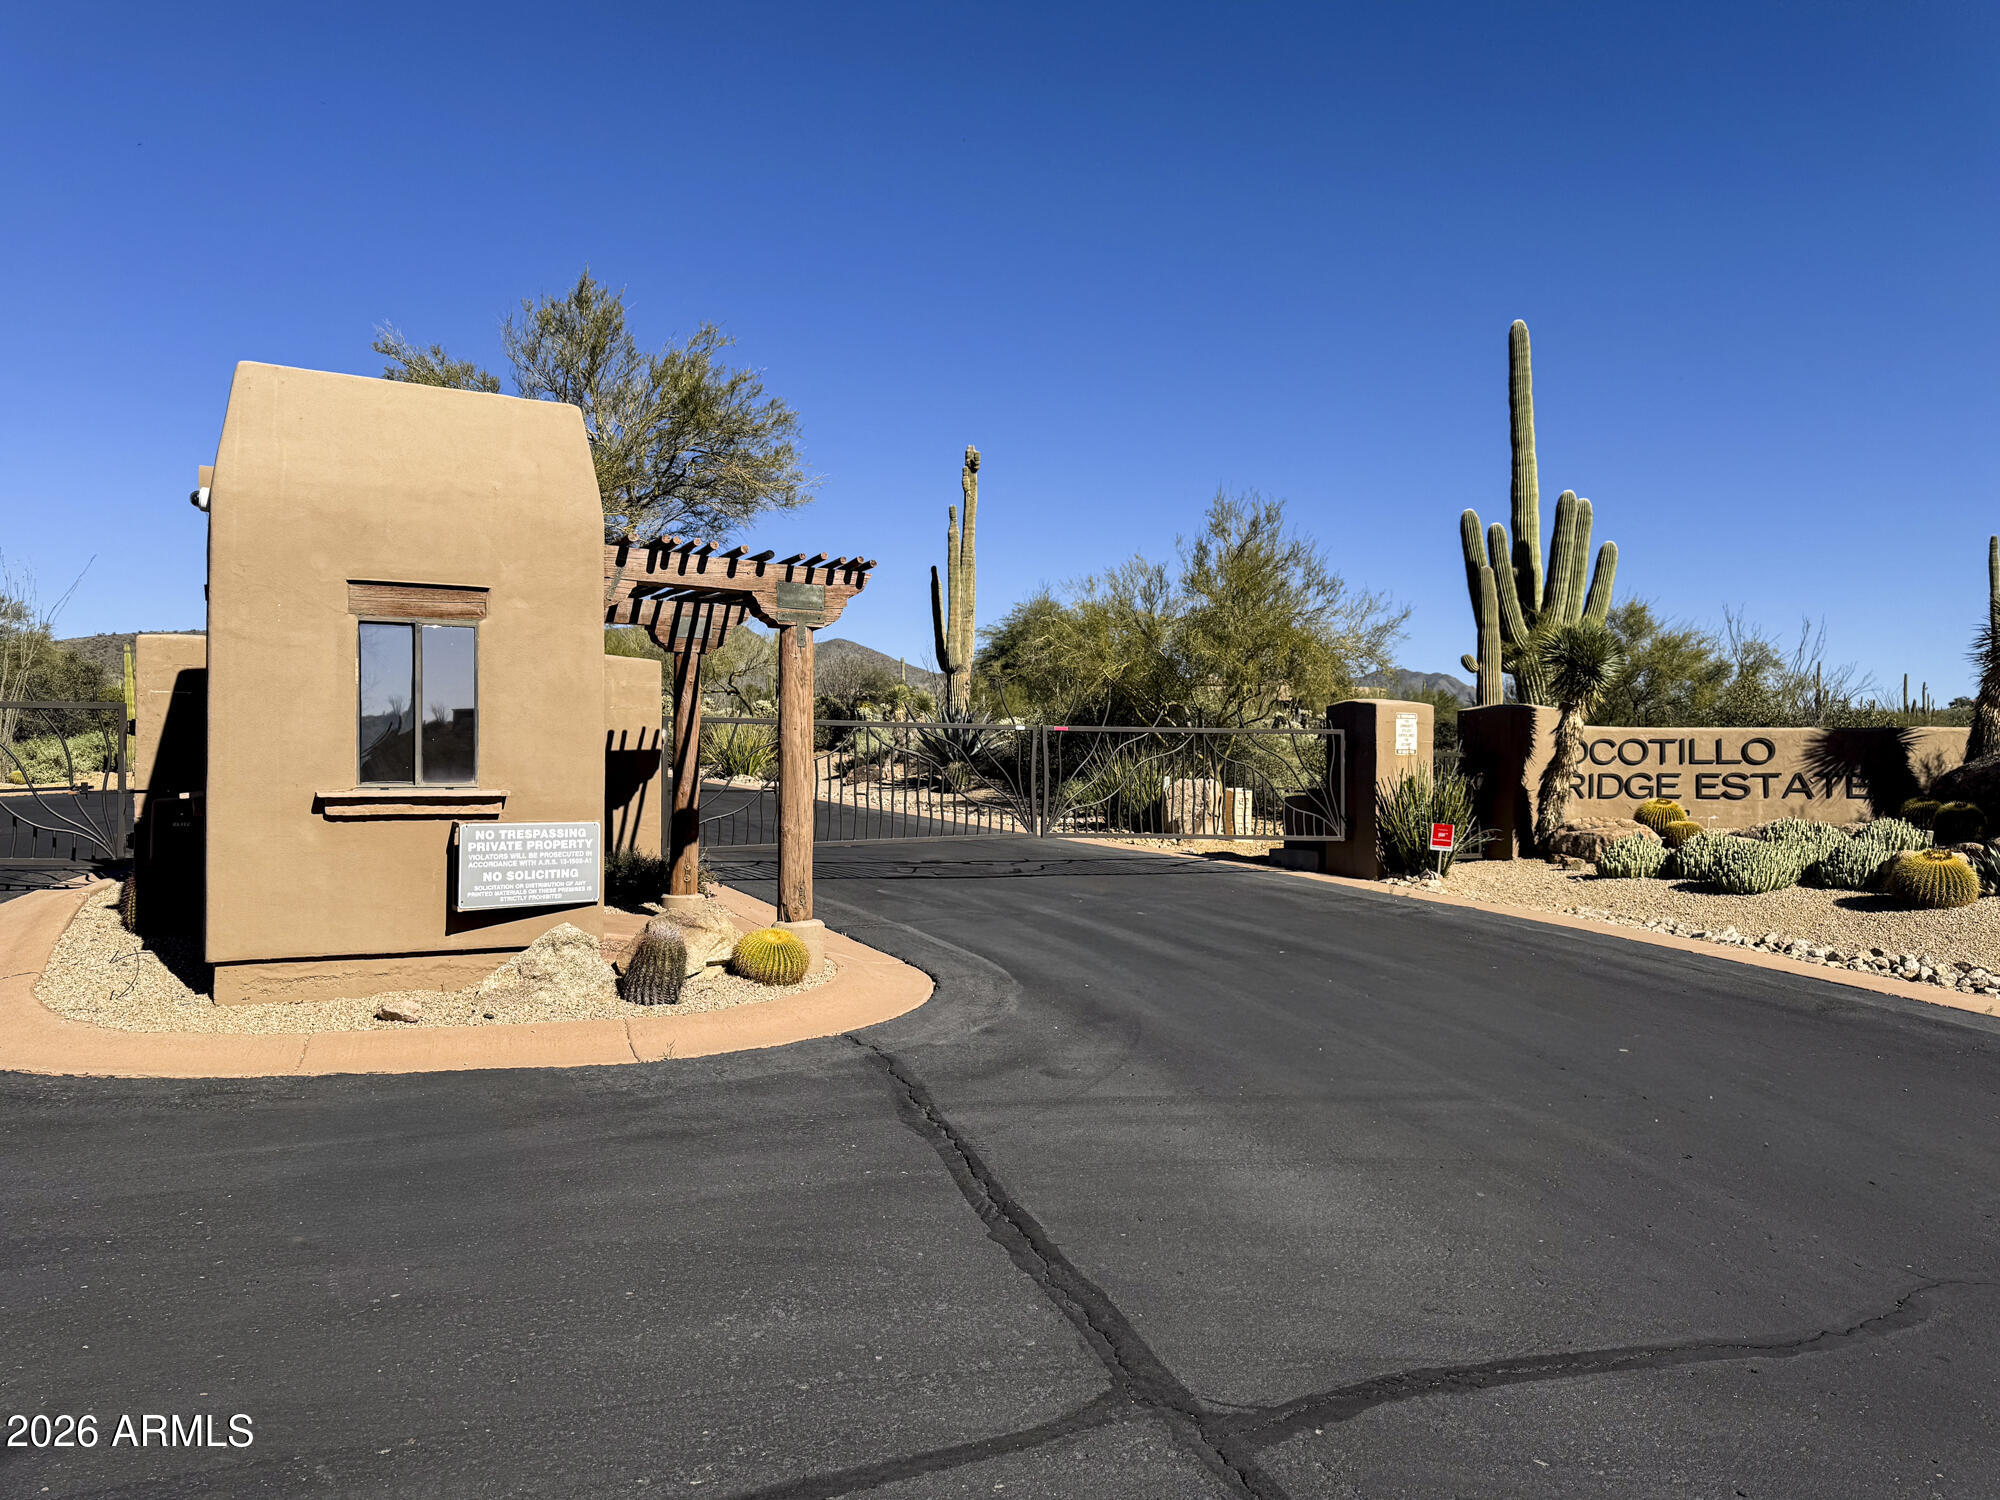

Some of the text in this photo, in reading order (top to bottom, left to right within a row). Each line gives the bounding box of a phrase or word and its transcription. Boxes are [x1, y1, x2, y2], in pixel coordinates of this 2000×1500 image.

[1569, 772, 1682, 799] RIDGE
[475, 828, 587, 841] NO TRESPASSING
[467, 839, 593, 852] PRIVATE PROPERTY
[468, 853, 509, 861] VIOLATORS
[509, 852, 527, 860] WILL
[528, 851, 539, 859] BE
[539, 850, 584, 858] PROSECUTED
[468, 860, 518, 869] ACCORDANCE
[519, 859, 537, 867] WITH
[482, 868, 579, 882] NO SOLICITING
[473, 883, 515, 891] SOLICITATION
[466, 890, 494, 898] PRINTED
